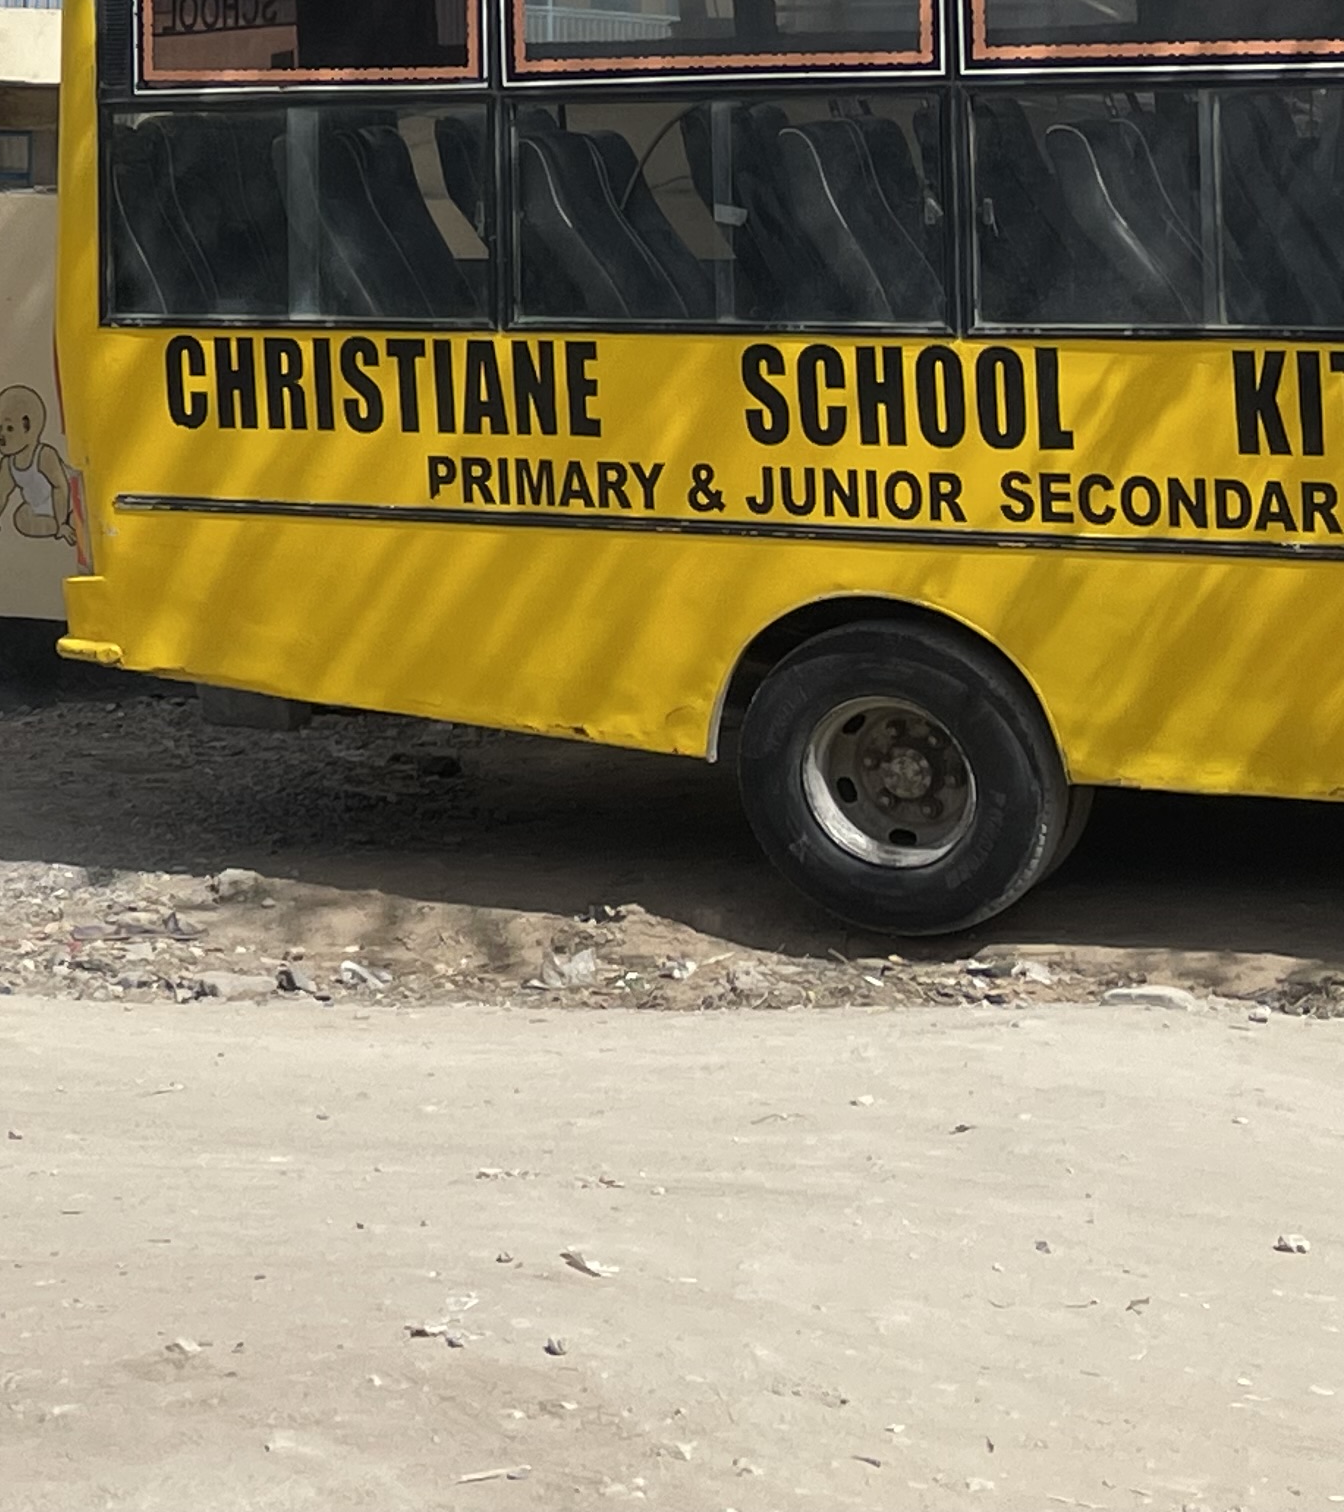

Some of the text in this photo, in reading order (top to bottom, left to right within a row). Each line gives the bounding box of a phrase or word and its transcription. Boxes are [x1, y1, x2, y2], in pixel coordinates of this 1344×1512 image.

[165, 335, 601, 437] CHRISTIANE
[741, 343, 1074, 450] SCHOOL
[427, 455, 1343, 534] PRIMARY & JUNIOR SECONDAR
